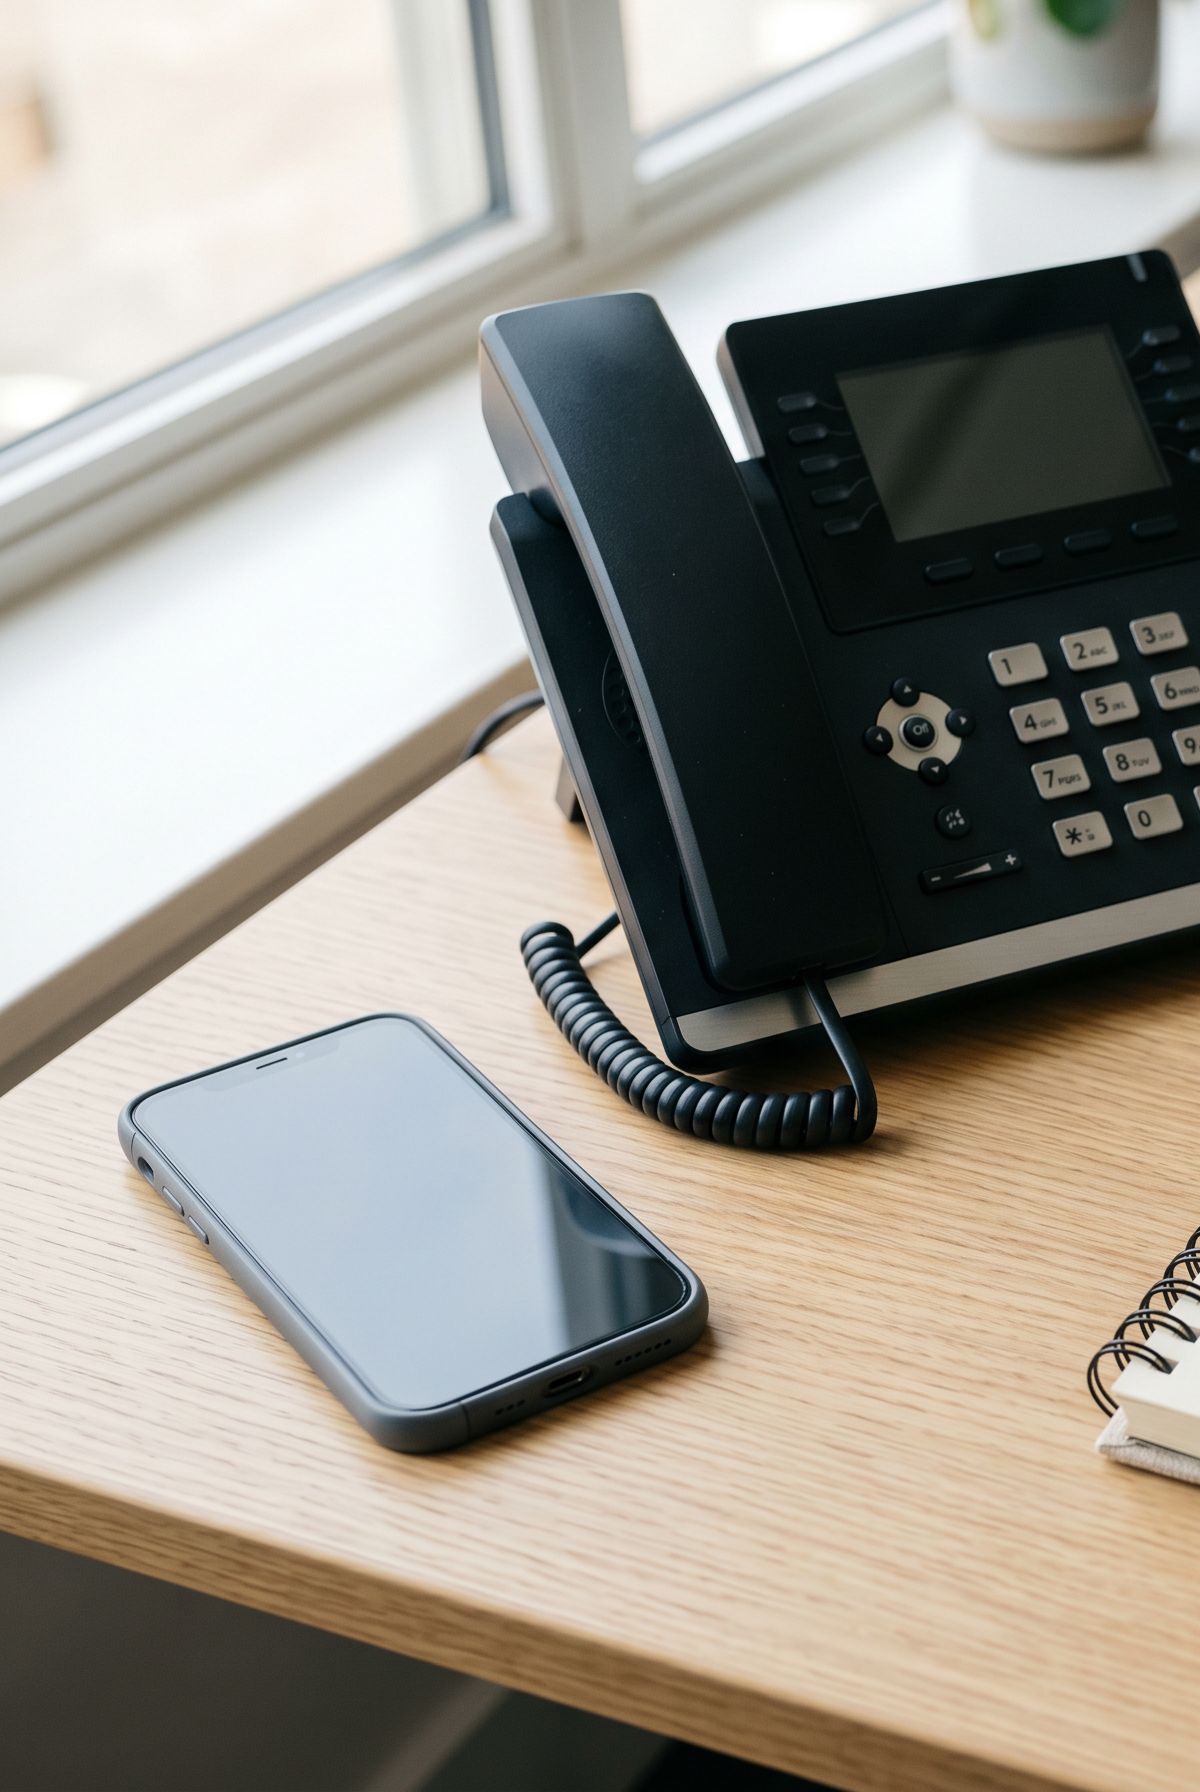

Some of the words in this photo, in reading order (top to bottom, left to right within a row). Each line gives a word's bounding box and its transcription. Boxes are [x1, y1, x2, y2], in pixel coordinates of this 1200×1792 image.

[1142, 626, 1156, 644] 3
[1073, 642, 1087, 660] 2
[1001, 658, 1012, 675] 1
[1164, 682, 1177, 700] 6
[1094, 696, 1108, 714] 5
[1024, 714, 1037, 731] 4
[1184, 737, 1196, 754] 9
[1116, 753, 1129, 771] 8
[1043, 769, 1054, 788] 7
[1138, 810, 1151, 827] 0
